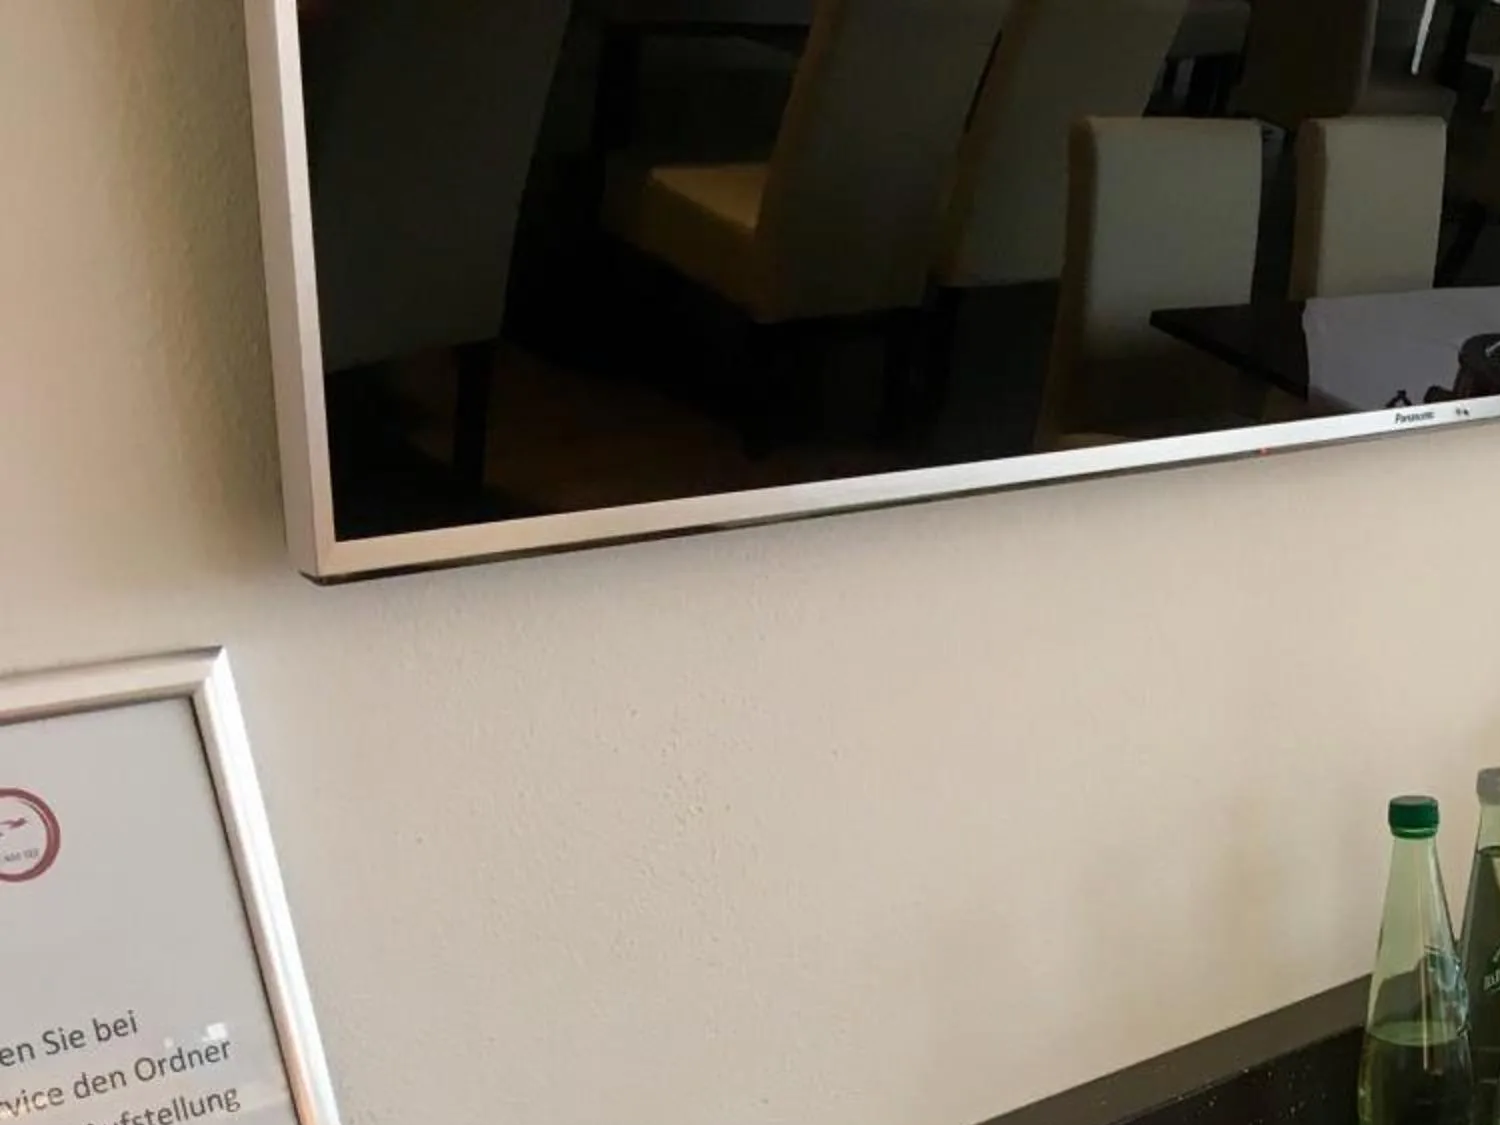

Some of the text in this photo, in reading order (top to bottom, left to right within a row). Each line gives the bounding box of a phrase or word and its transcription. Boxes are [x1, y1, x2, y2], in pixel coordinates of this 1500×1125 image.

[42, 1027, 87, 1056] Sie
[93, 1010, 139, 1042] bei
[73, 1072, 128, 1099] den
[134, 1041, 232, 1081] Ordner
